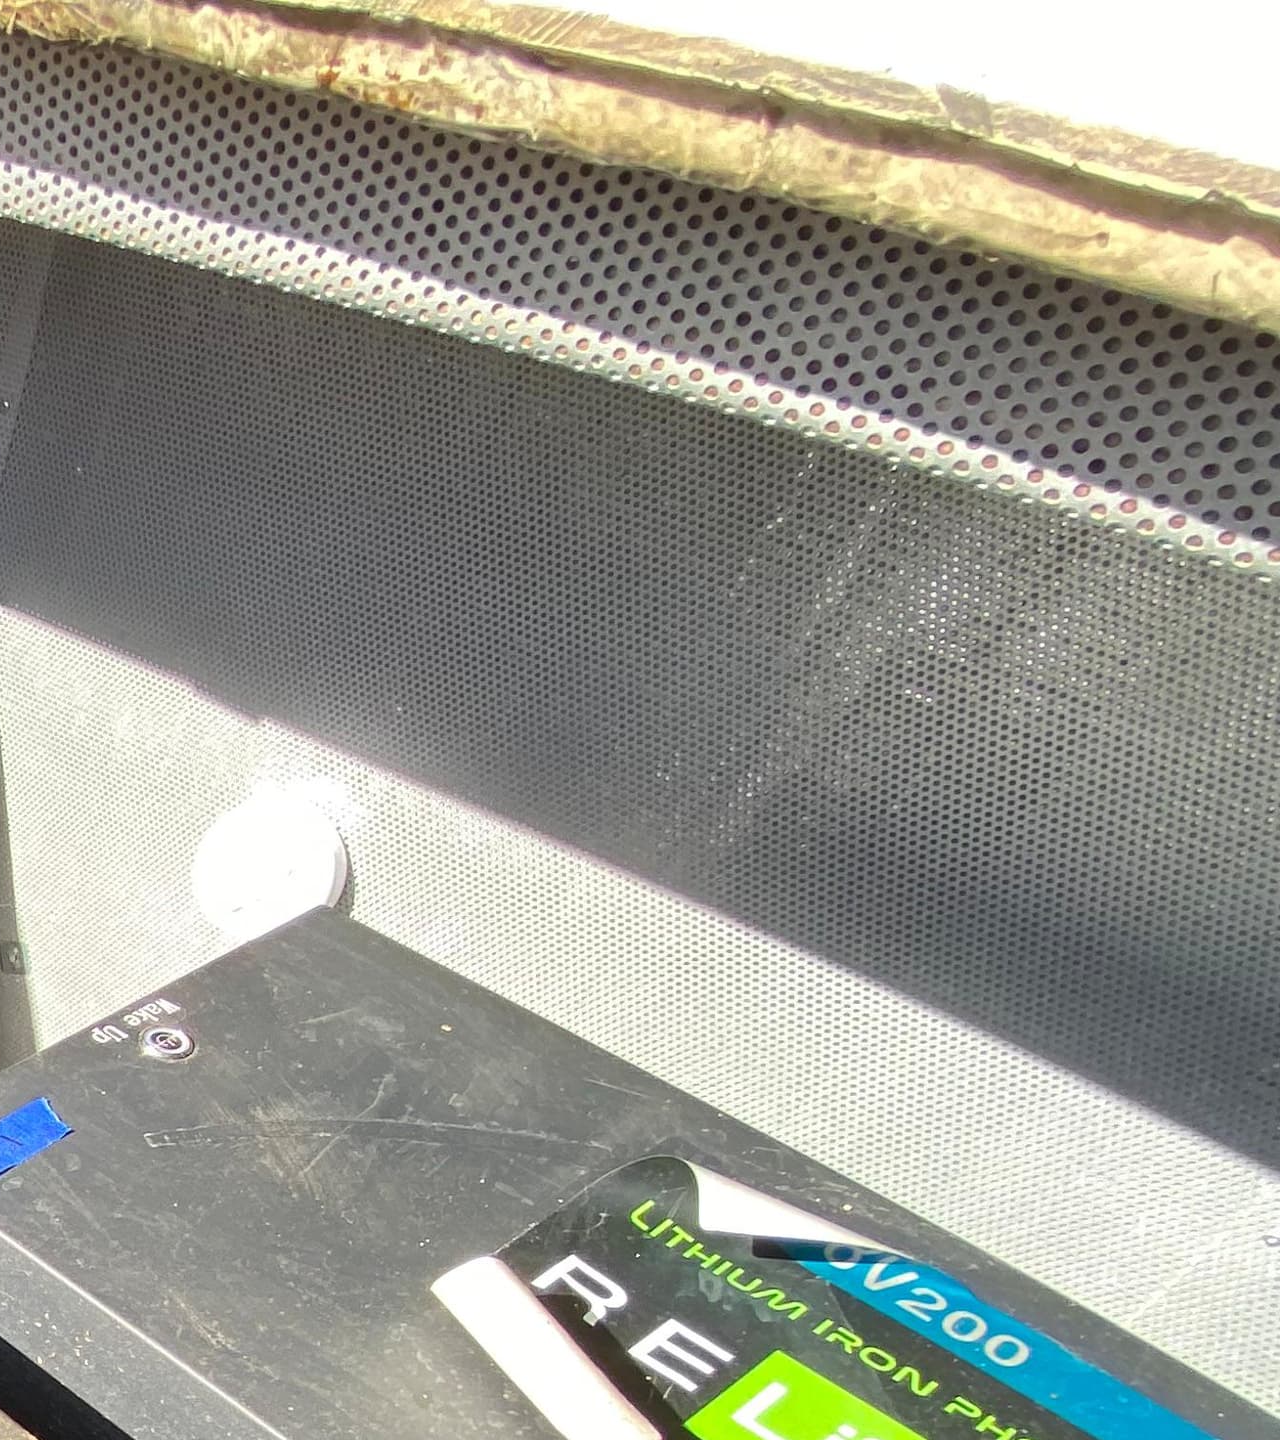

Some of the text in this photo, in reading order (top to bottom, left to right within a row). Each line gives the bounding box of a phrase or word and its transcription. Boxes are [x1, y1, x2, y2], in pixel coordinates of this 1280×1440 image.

[92, 997, 181, 1044] Wake Up
[629, 1199, 809, 1321] LITHIUM
[812, 1318, 939, 1398] IRON
